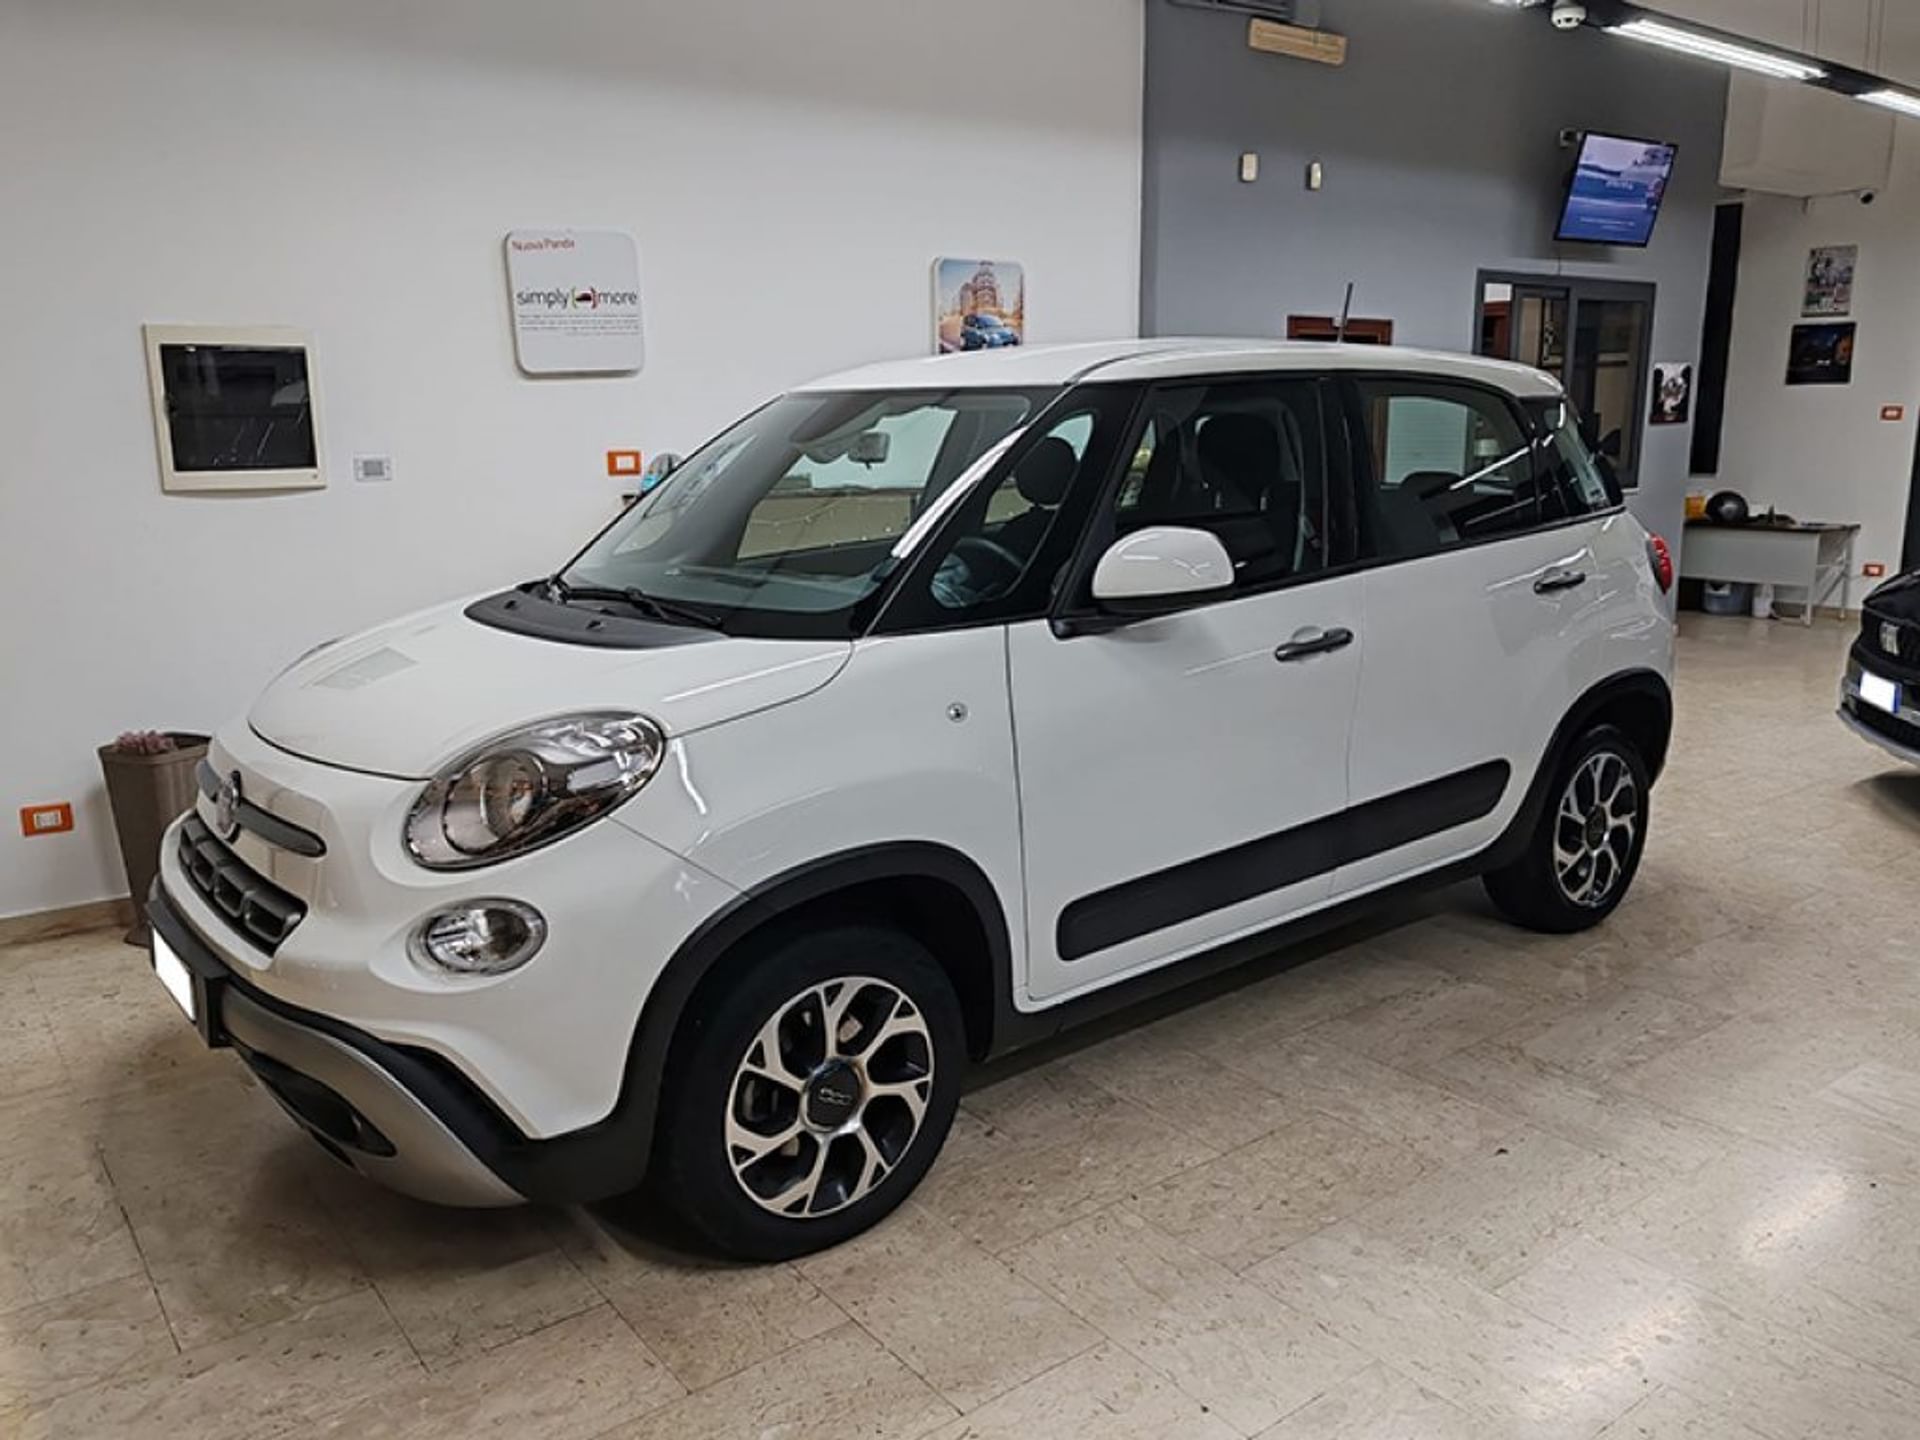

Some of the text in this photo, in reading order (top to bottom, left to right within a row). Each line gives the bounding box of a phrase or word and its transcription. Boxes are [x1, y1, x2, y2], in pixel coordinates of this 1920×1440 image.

[511, 238, 575, 251] Nuova Panda
[516, 288, 638, 309] simply more
